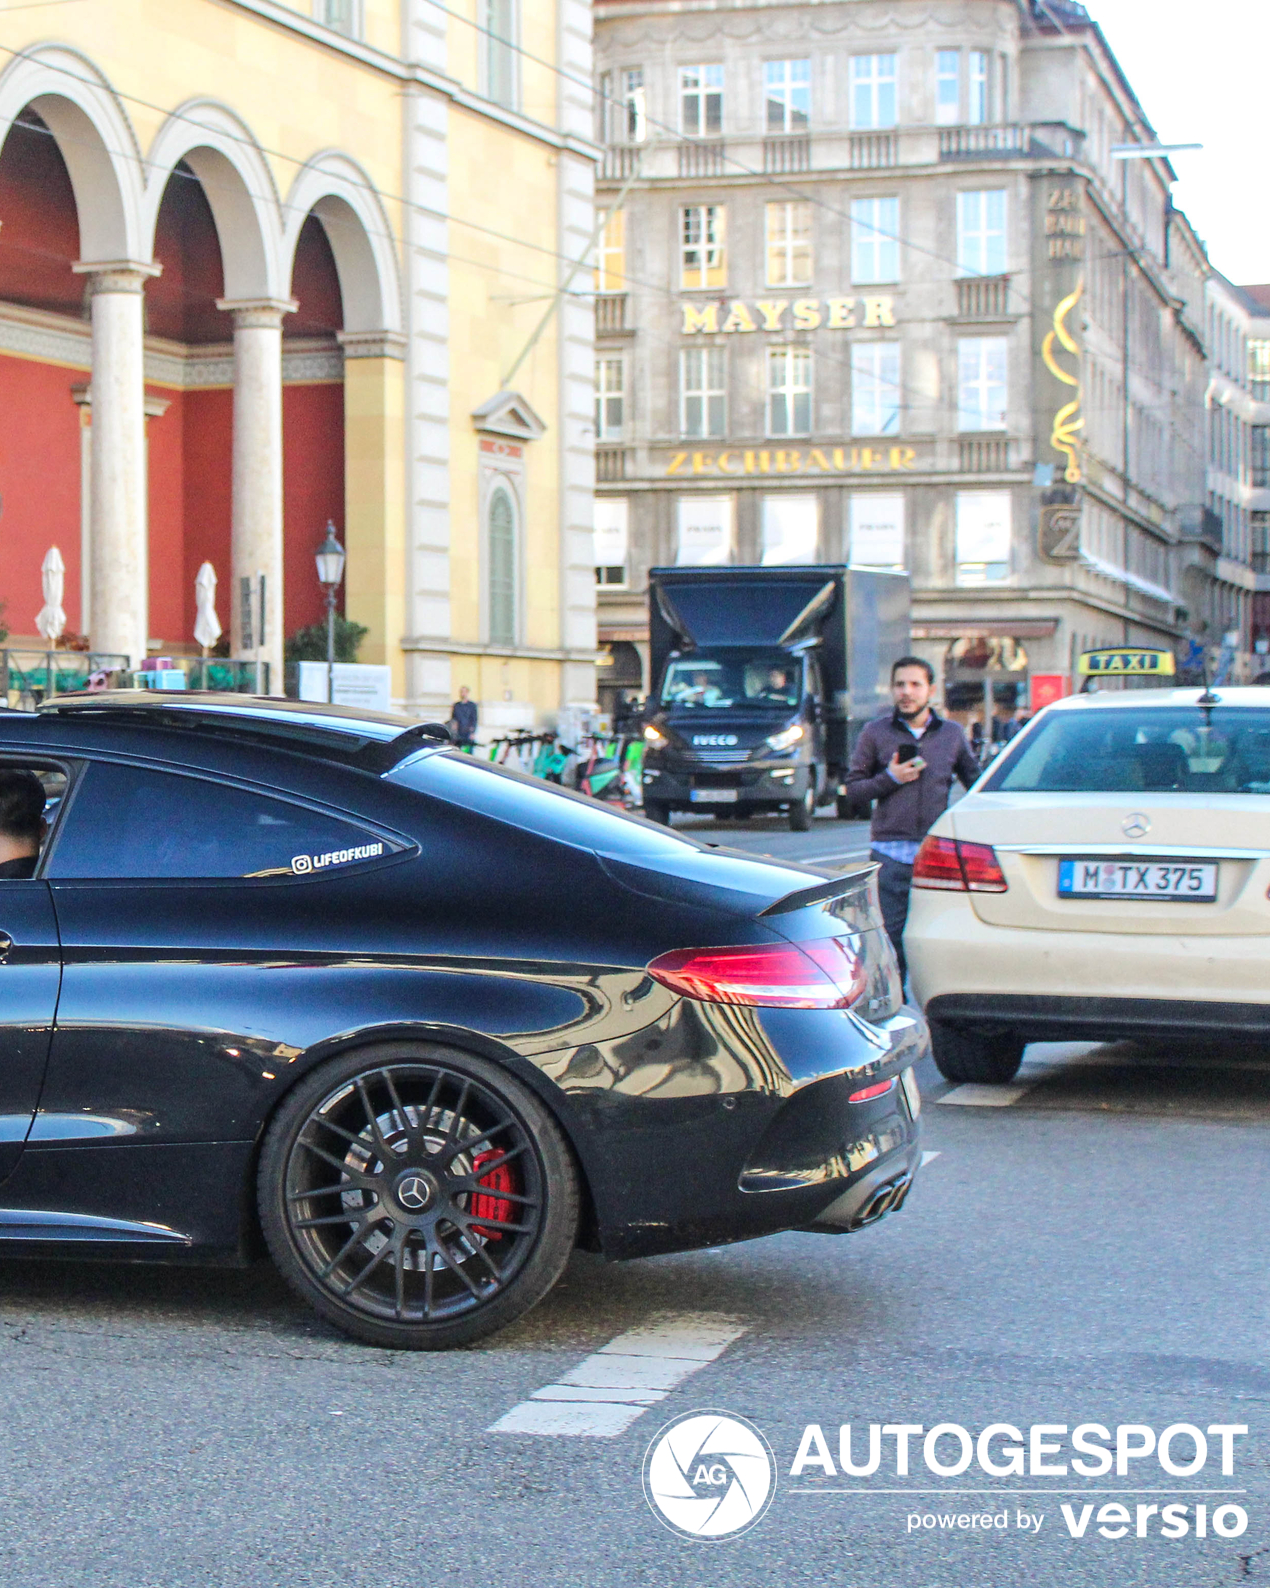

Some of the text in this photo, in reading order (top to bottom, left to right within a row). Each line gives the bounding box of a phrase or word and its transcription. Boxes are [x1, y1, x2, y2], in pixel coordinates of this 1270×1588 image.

[682, 296, 897, 334] MAYSER
[665, 447, 917, 476] ZECHBAUER
[1096, 655, 1152, 670] TAXI
[692, 734, 738, 746] IVECO
[313, 842, 383, 868] LIFEOFKUBI
